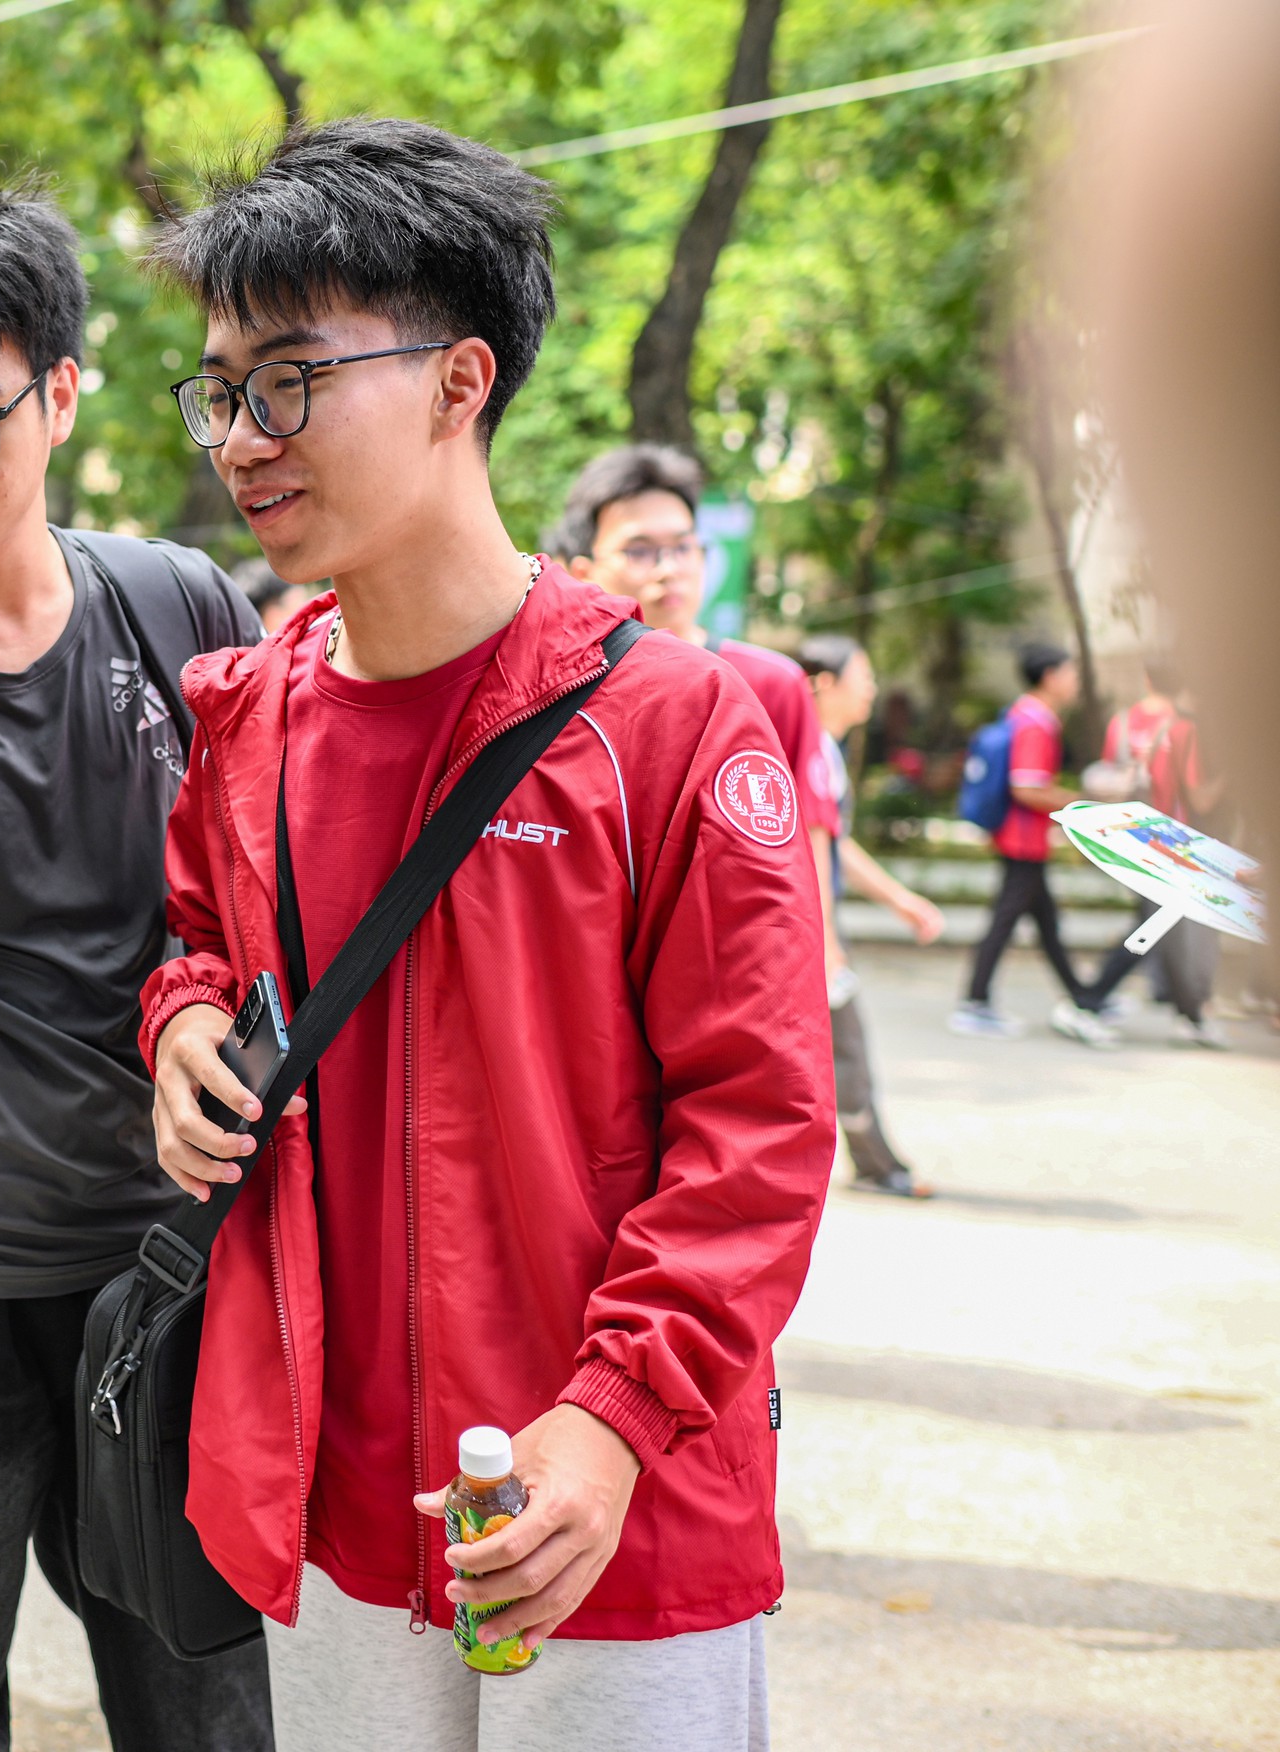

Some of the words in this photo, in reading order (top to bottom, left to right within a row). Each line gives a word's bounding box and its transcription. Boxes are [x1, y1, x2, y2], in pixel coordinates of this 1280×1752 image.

[481, 819, 570, 847] HUST
[757, 818, 778, 829] 1956
[768, 1391, 778, 1428] HUST
